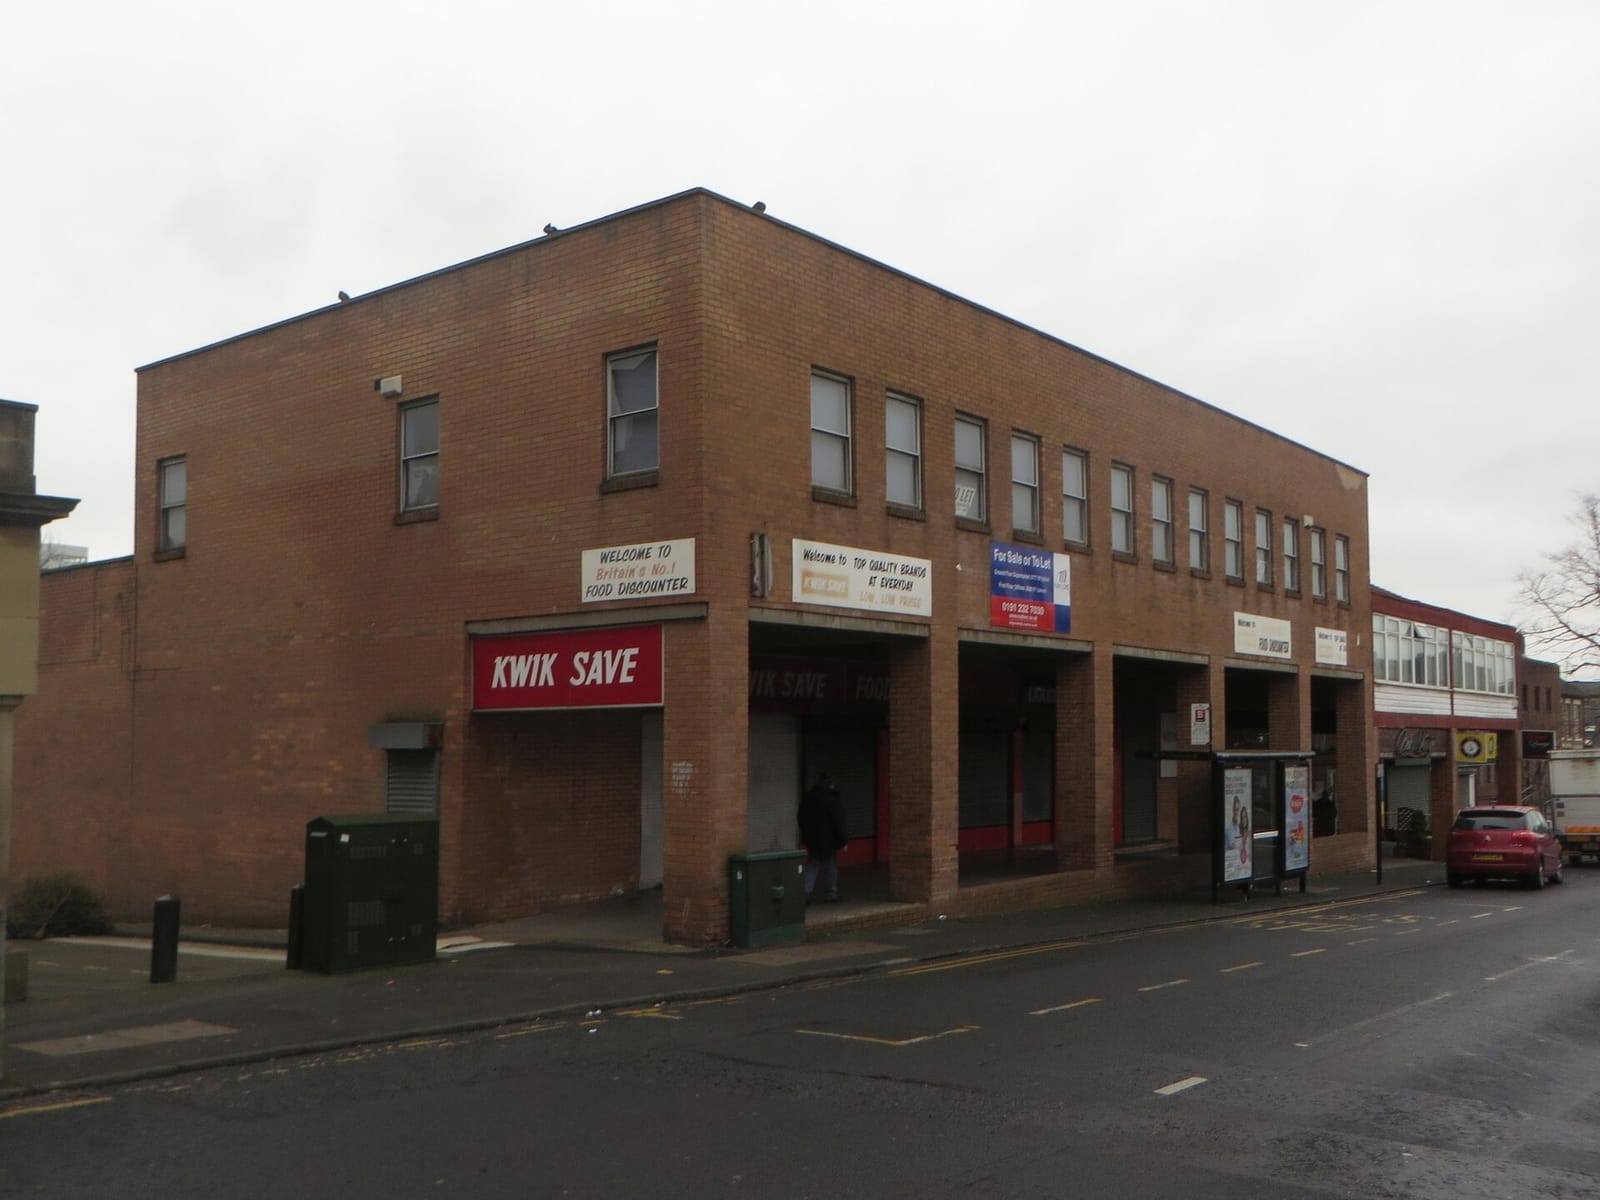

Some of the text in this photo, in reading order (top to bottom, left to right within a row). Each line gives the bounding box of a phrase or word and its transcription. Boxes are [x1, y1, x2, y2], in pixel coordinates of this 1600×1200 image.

[960, 488, 974, 504] LET
[600, 544, 672, 564] WELCOME TO
[802, 549, 927, 578] Welcome to TOP QUALITY BRANDS
[994, 548, 1052, 570] For Sale or To Let
[585, 577, 689, 598] FOOD DISCOUNTER
[868, 576, 914, 592] AT EVERYDAY
[491, 647, 640, 689] KWIK SAVE
[782, 672, 829, 699] SAVE
